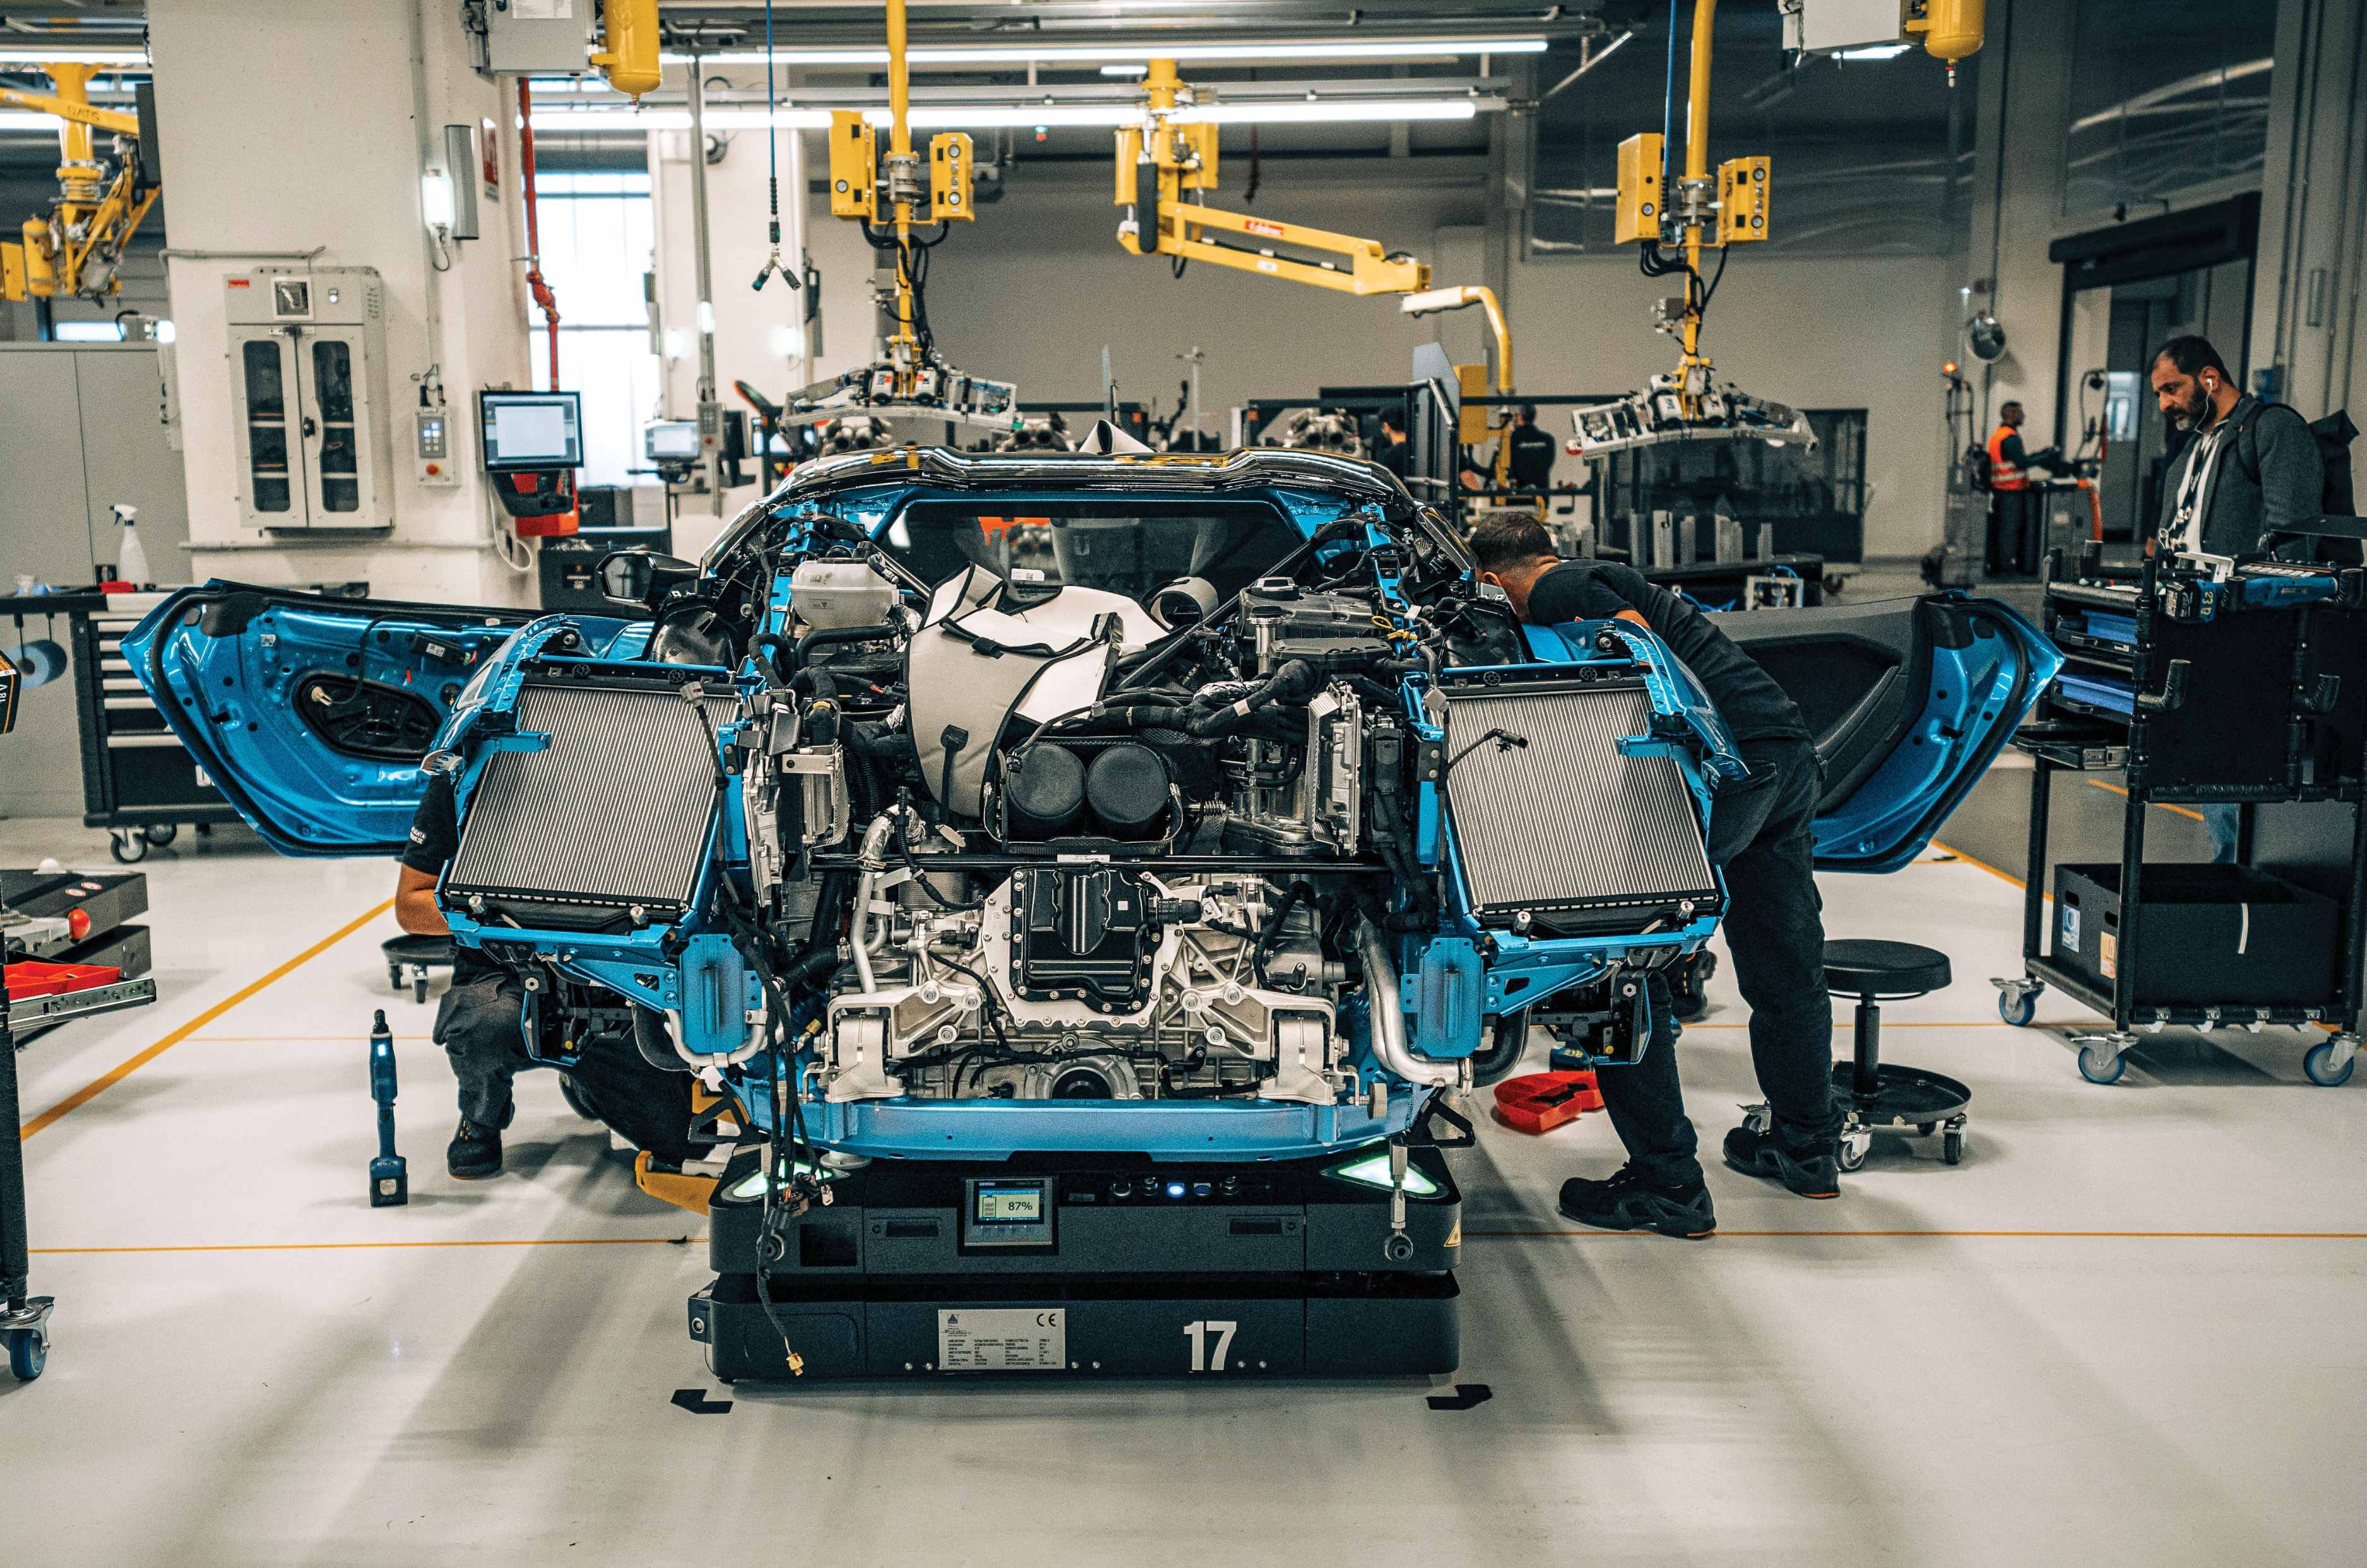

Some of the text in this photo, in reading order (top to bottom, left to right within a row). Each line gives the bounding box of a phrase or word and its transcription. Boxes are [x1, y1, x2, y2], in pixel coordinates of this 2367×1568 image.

[1008, 1201, 1033, 1211] 87%
[1036, 1313, 1056, 1327] CE
[1184, 1321, 1237, 1370] 17
